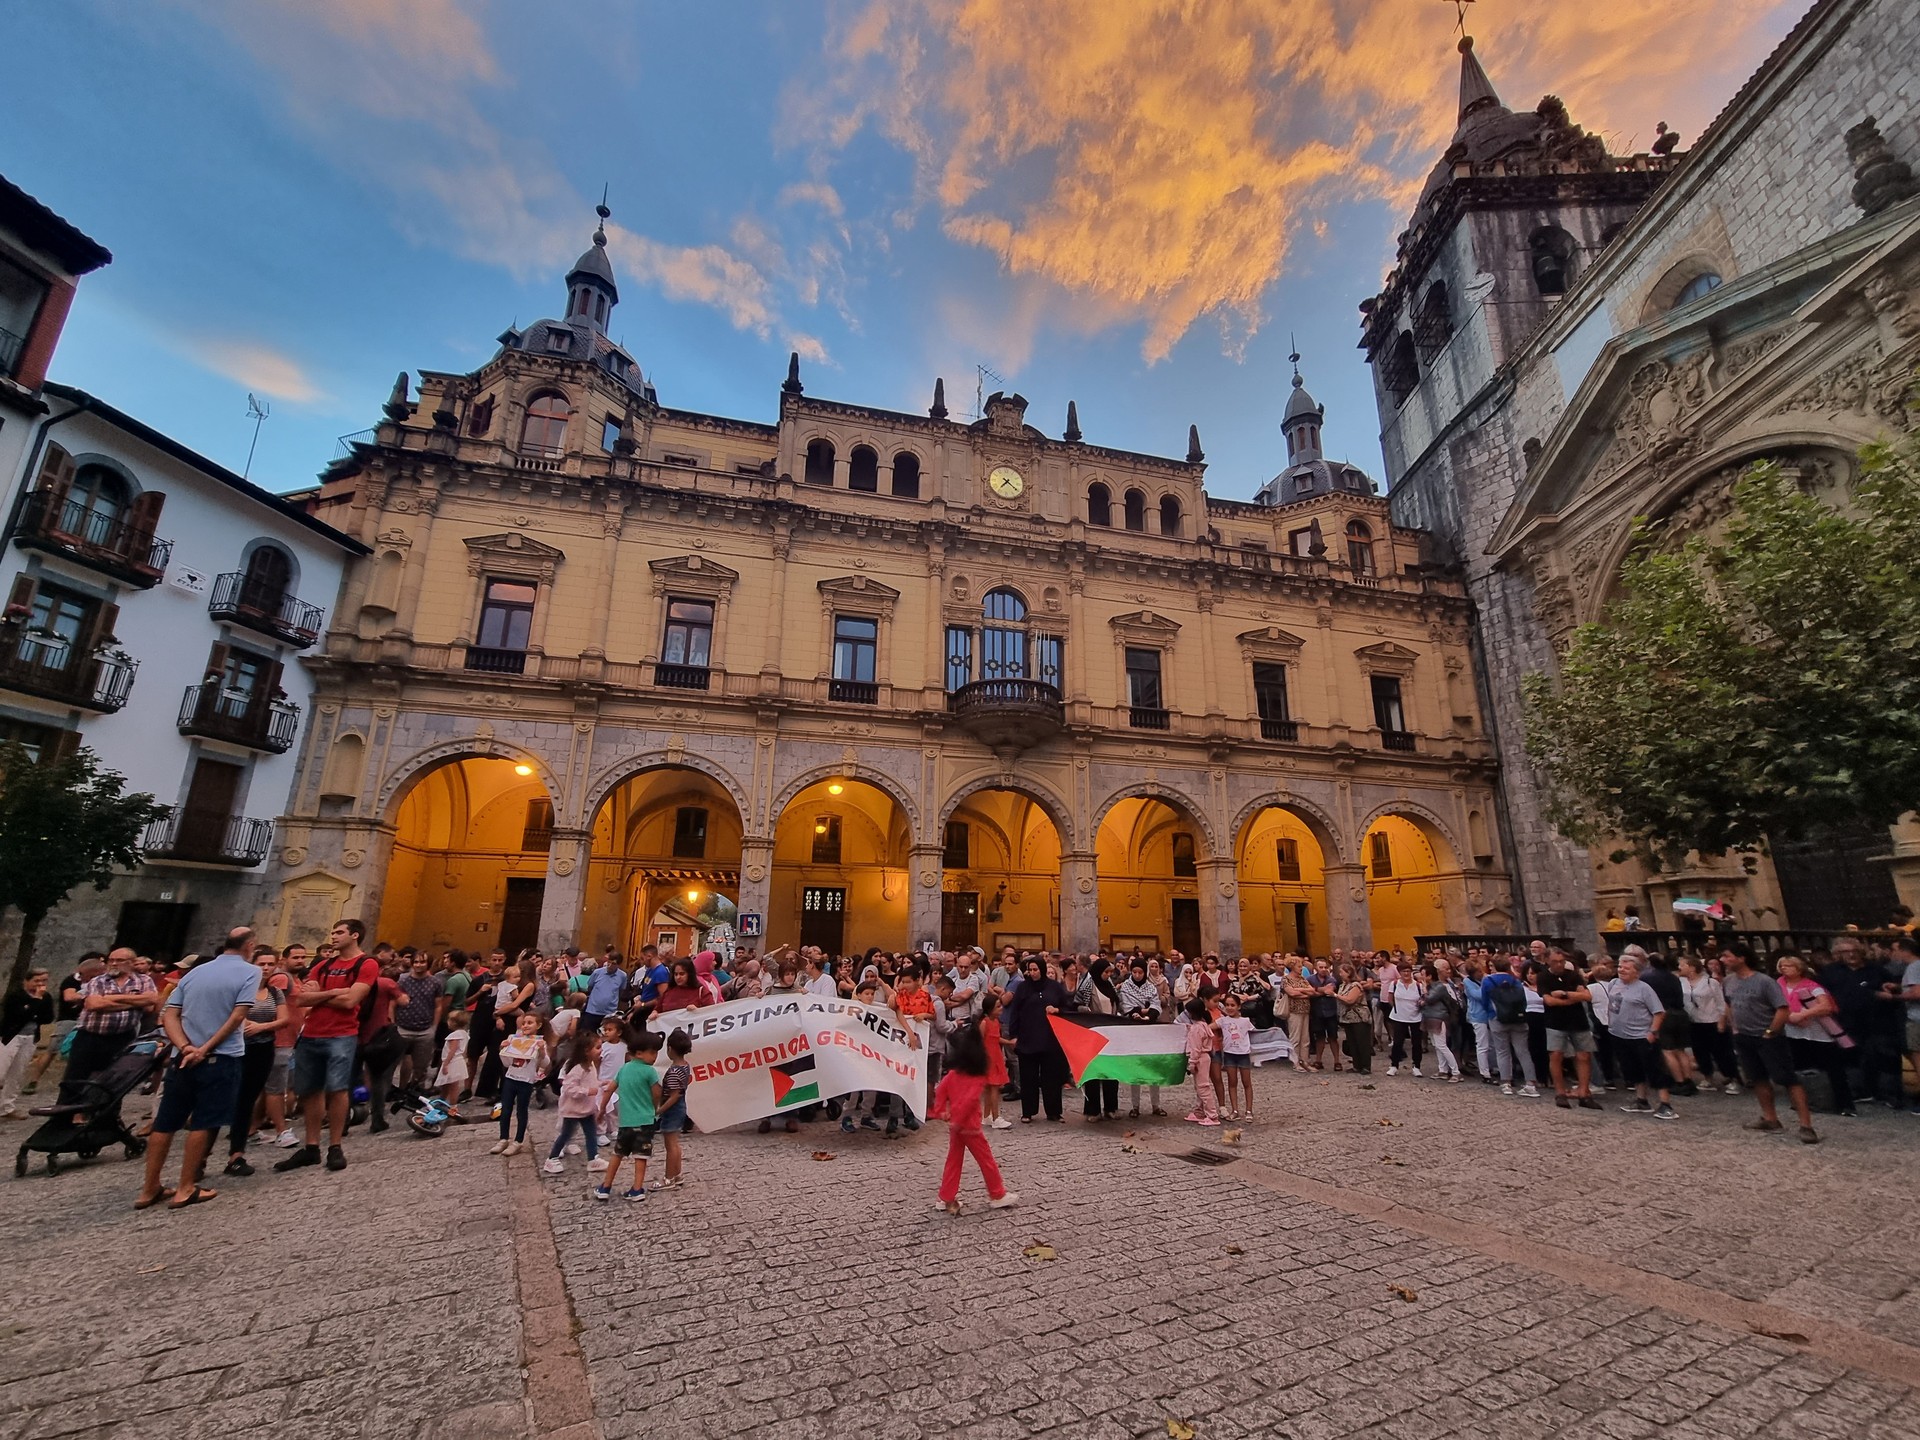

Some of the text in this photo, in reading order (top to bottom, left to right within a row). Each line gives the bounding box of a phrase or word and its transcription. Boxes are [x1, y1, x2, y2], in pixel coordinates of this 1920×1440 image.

[657, 1001, 800, 1050] LESTINA
[687, 1030, 916, 1085] ENOZIDIOA GELDITU!
